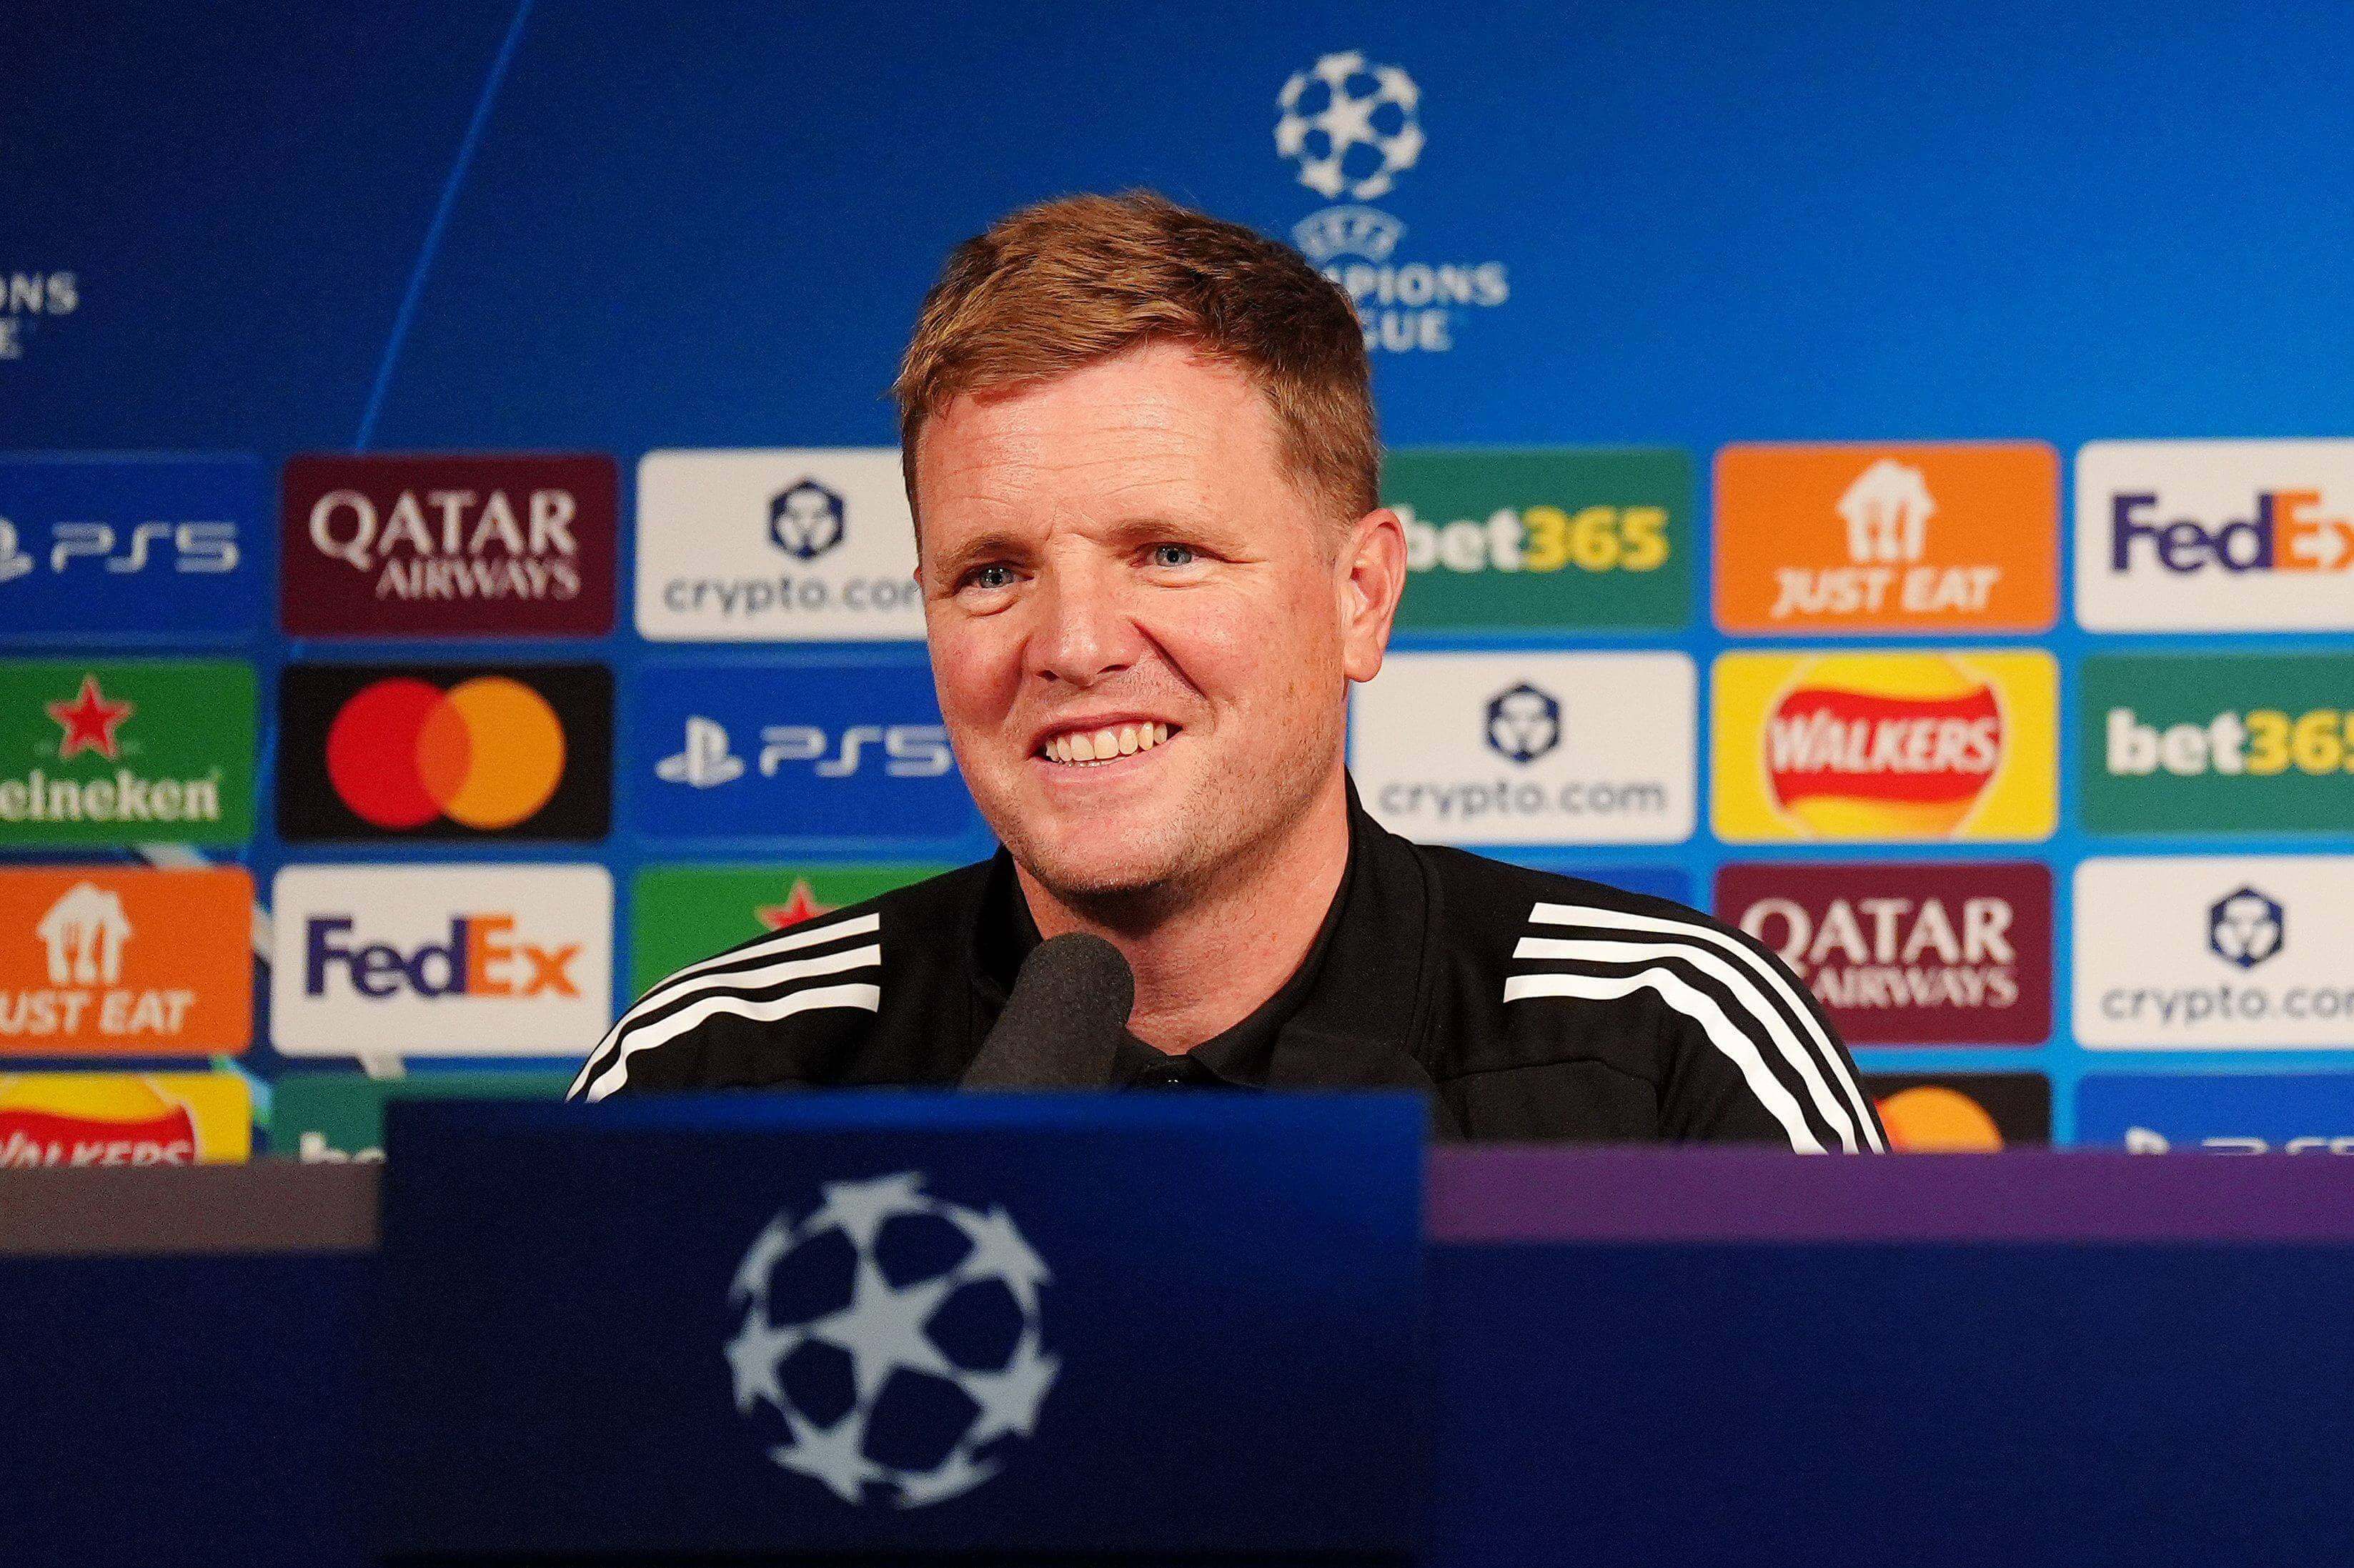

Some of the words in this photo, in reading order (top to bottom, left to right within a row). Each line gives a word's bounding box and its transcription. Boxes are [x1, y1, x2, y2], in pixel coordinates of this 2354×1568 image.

[0, 269, 79, 314] NS
[51, 521, 239, 572] PS5
[309, 489, 579, 570] QATAR
[1391, 505, 1669, 572] bet365
[375, 558, 582, 600] AIRWAYS
[1771, 567, 1892, 619] JUST
[1901, 565, 2001, 613] EAT
[758, 725, 954, 778] PS5
[1769, 705, 2003, 773] WALKERS
[2106, 707, 2354, 776] bet36
[303, 913, 584, 999] FedEx
[1738, 898, 2019, 978] QATAR
[99, 989, 194, 1035] EAT
[1811, 965, 2020, 1008] AIRWAYS
[2100, 985, 2354, 1031] crypto.co
